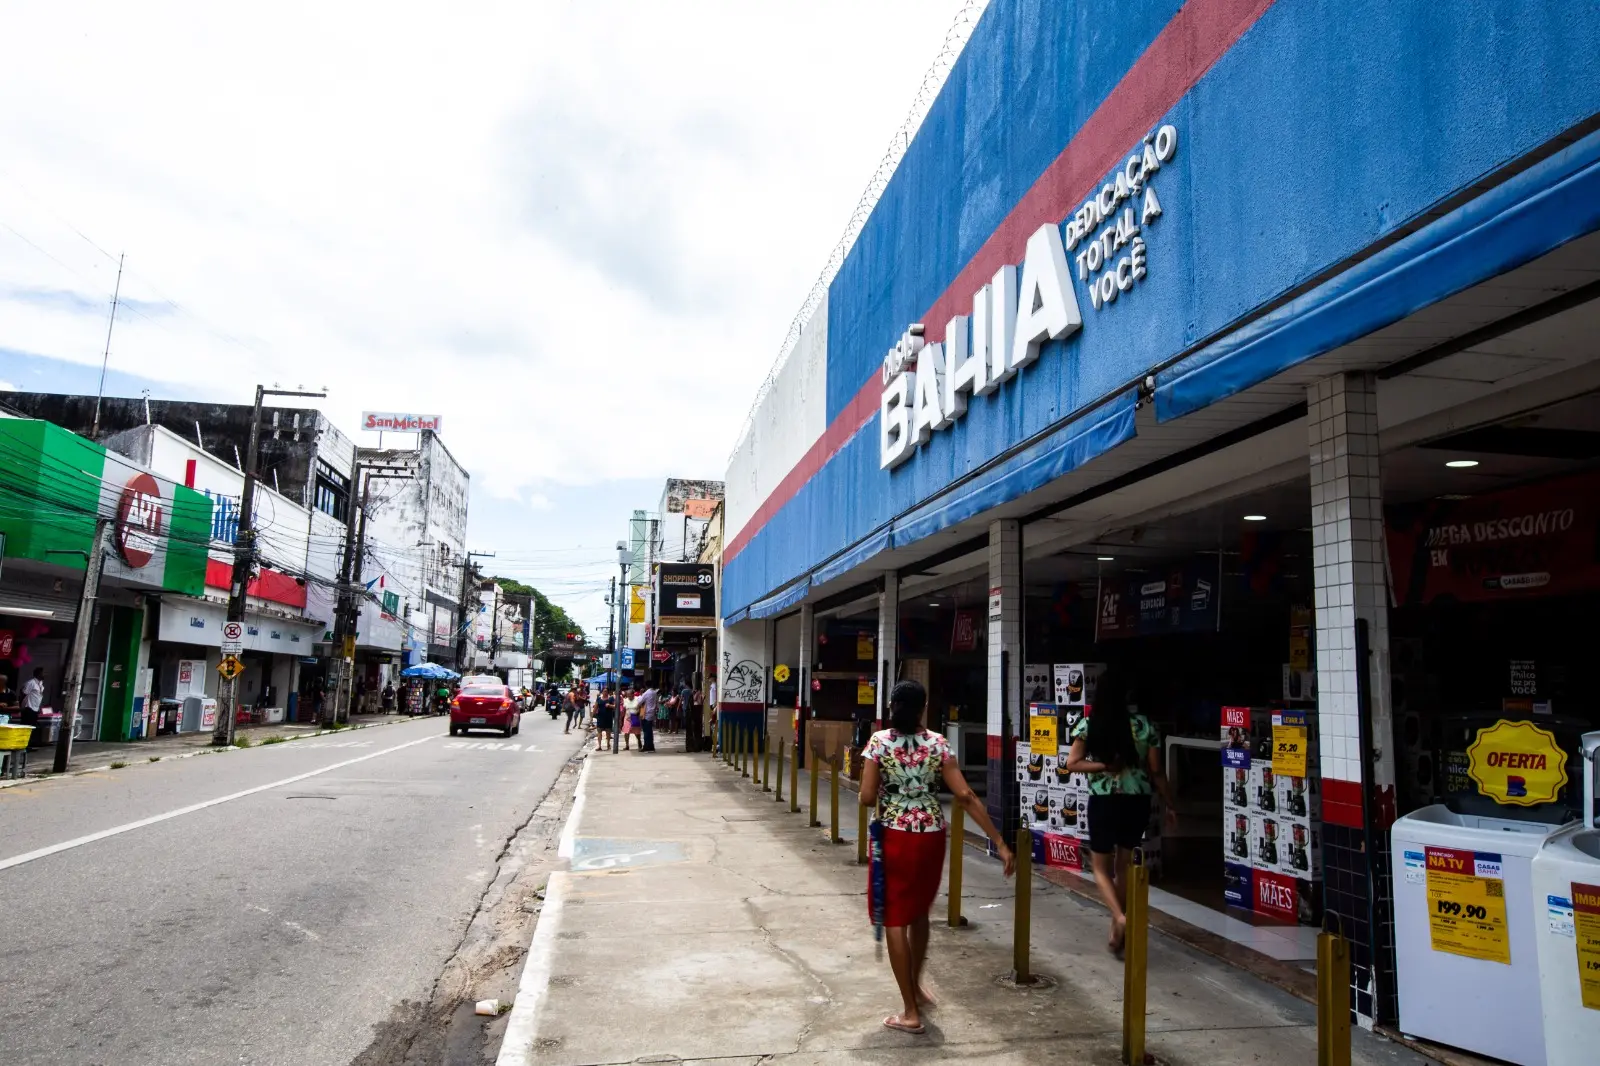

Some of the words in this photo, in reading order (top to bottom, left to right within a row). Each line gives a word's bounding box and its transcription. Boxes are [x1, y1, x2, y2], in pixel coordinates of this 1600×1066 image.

[1066, 125, 1177, 251] DEDICAÇÃO
[1076, 208, 1138, 281] TOTAL
[1142, 187, 1161, 225] A
[1089, 237, 1146, 310] VOCÊ
[880, 223, 1083, 470] BAHIA
[365, 414, 438, 430] SanMichel
[126, 491, 162, 532] ART
[1425, 524, 1471, 547] MEGA
[1474, 508, 1574, 542] DESCONTO
[1431, 549, 1448, 566] EM
[698, 575, 712, 584] 20
[1511, 670, 1536, 679] Philco
[1511, 686, 1537, 695] você
[1278, 743, 1298, 753] 25,20
[1487, 752, 1547, 770] OFERTA
[1050, 840, 1077, 862] MÃES
[1429, 855, 1446, 868] NA
[1448, 858, 1464, 870] TV
[1477, 863, 1500, 871] CASAS
[1260, 880, 1292, 909] MÃES
[1438, 900, 1486, 920] 199,90
